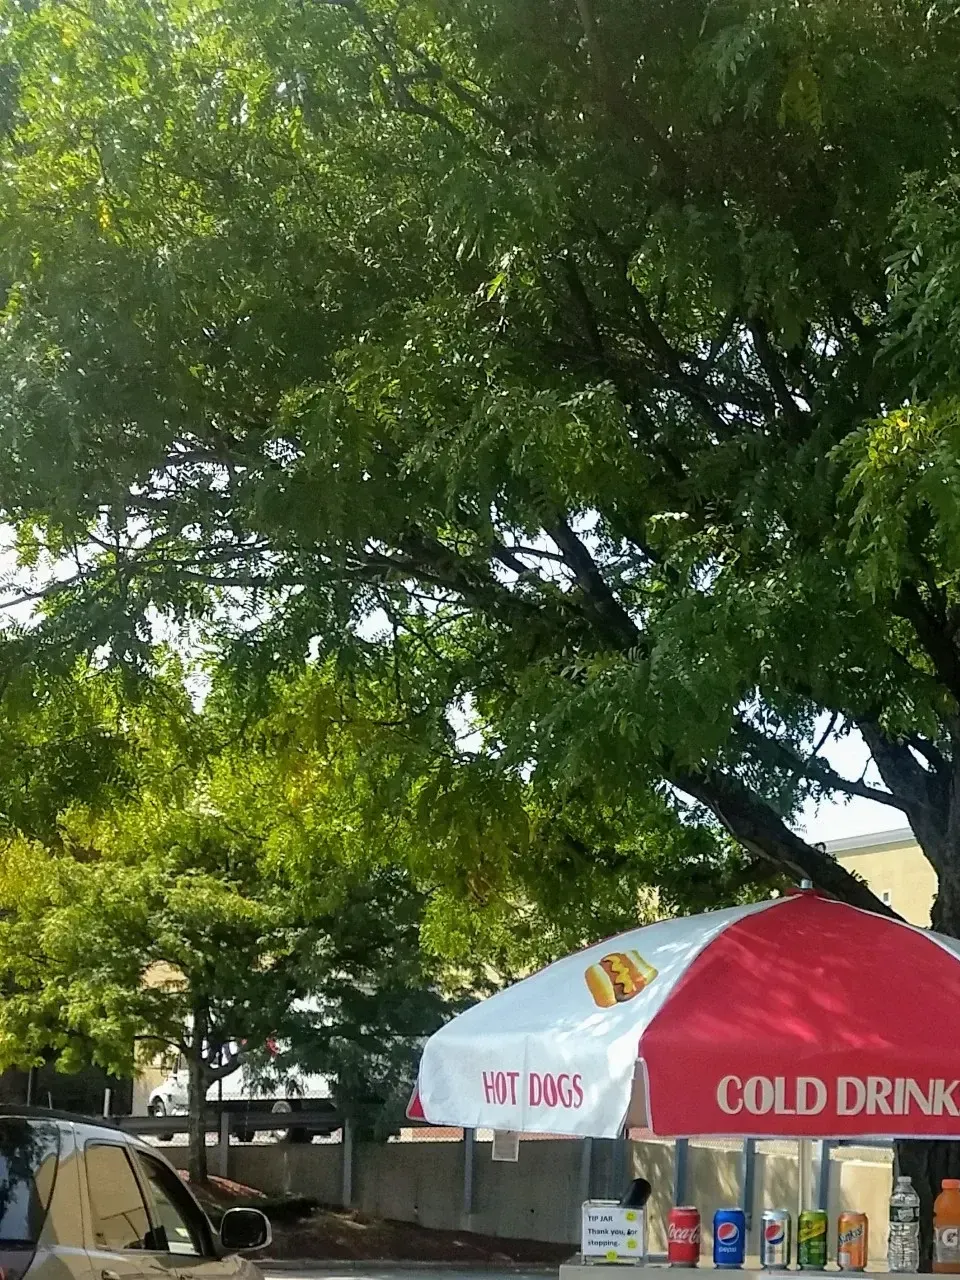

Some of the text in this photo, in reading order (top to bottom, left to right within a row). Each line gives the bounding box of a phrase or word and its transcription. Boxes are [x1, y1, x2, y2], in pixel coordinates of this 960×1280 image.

[482, 1071, 583, 1108] HOT DOGS
[716, 1075, 827, 1116] COLD
[588, 1239, 620, 1247] stopping.
[941, 1228, 958, 1246] G
